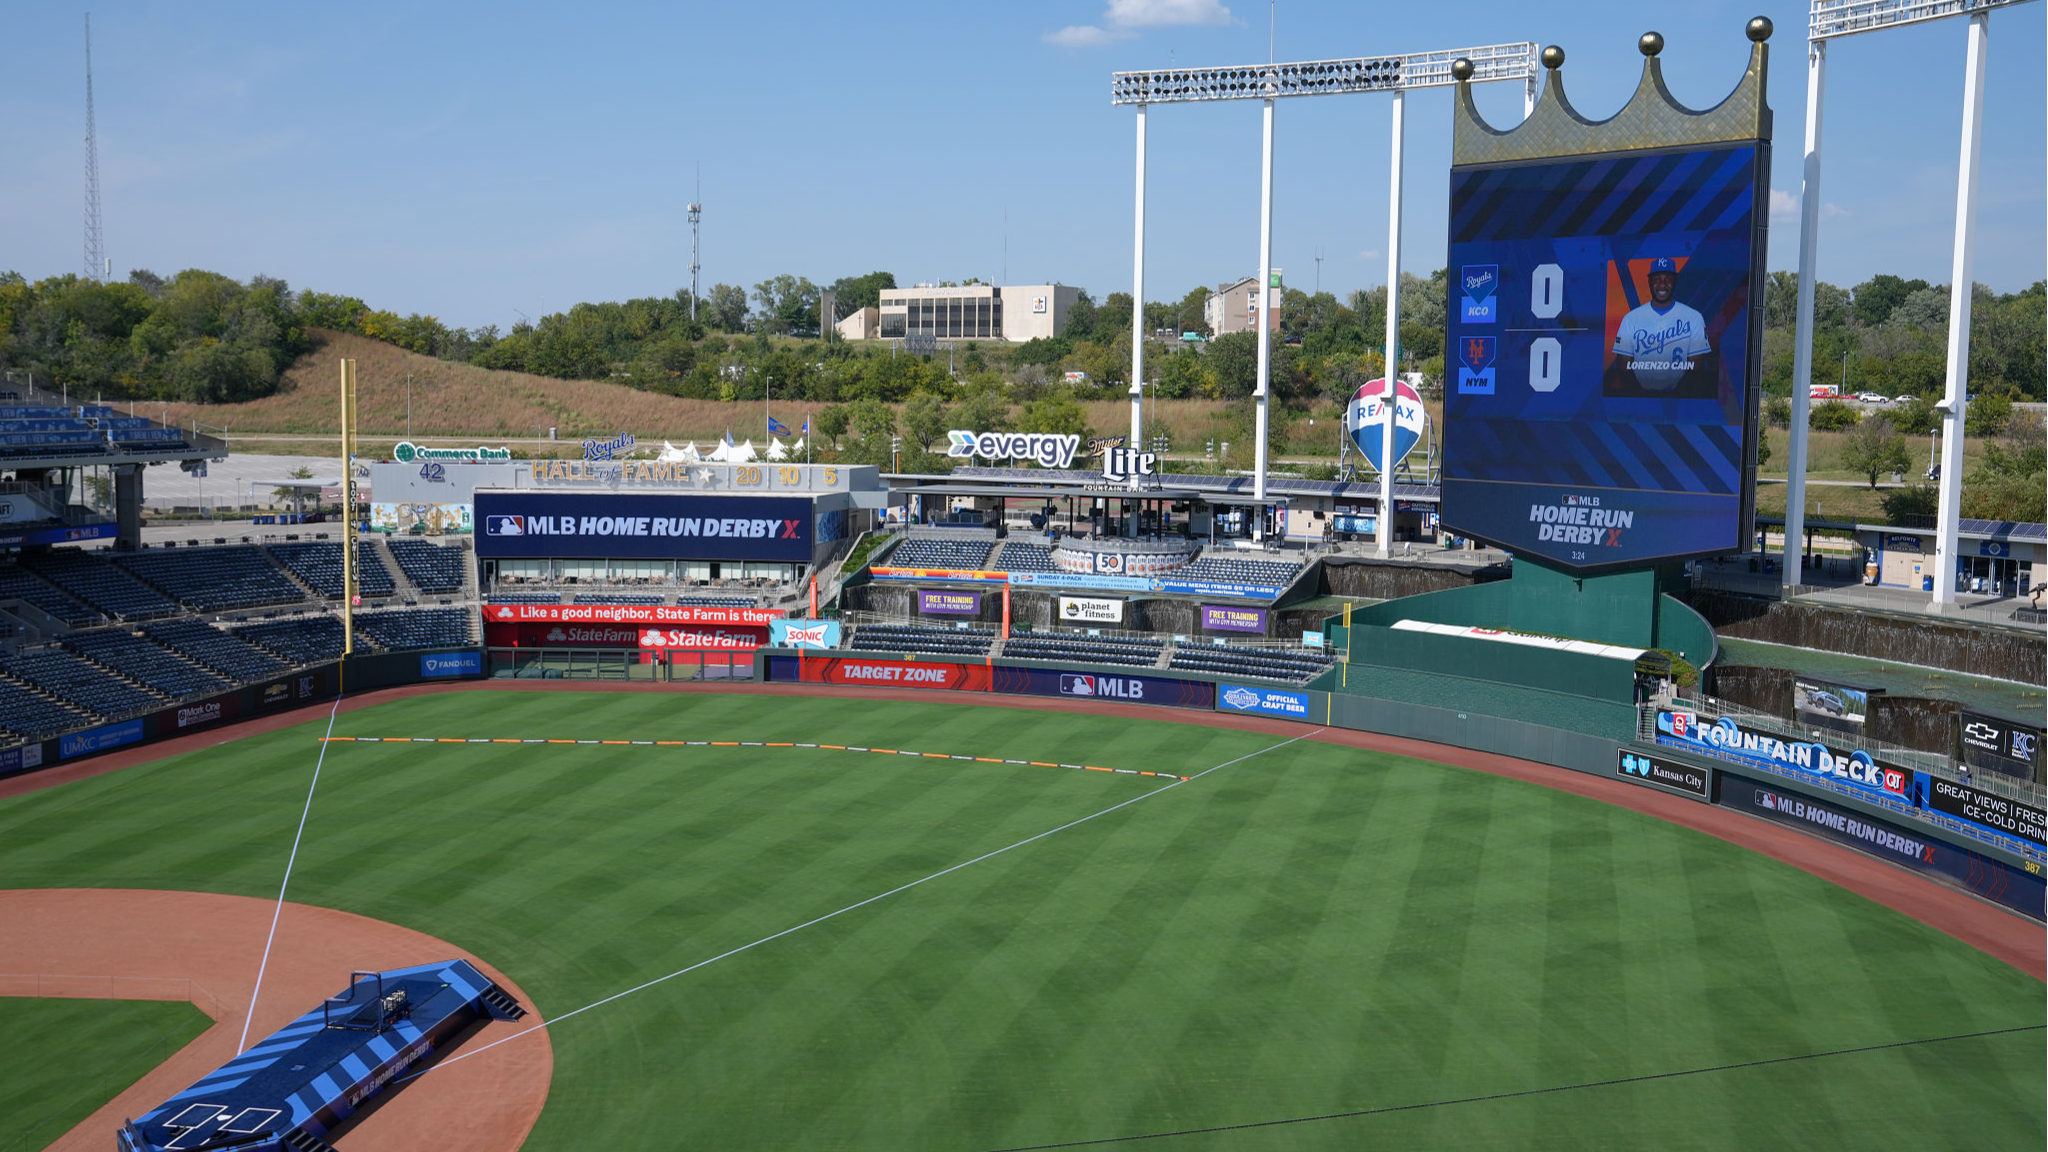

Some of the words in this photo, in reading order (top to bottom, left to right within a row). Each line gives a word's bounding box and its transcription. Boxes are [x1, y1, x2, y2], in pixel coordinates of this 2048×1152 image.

[1466, 271, 1492, 289] Royals
[1531, 263, 1563, 318] 0
[1468, 306, 1489, 316] KCO
[1633, 319, 1691, 355] Royals
[1529, 337, 1561, 392] 0
[1626, 361, 1670, 370] LORENZO
[1670, 361, 1694, 370] CAIN
[1465, 378, 1488, 387] NYM
[1357, 403, 1415, 421] RE/AX
[416, 448, 477, 460] Commerce
[480, 447, 510, 459] Bank
[582, 432, 637, 461] Royals
[980, 436, 1077, 466] evergy
[1087, 437, 1123, 453] Miller
[419, 463, 443, 480] 42
[532, 461, 594, 479] HALL
[599, 463, 622, 482] of
[621, 461, 689, 481] FAME
[1102, 447, 1157, 482] Lite
[736, 466, 760, 484] 20
[778, 466, 798, 484] 10
[824, 466, 836, 484] 5
[1083, 484, 1123, 492] FOUNTAIN
[1579, 496, 1599, 506] MLB
[1530, 505, 1589, 525] HOME
[1589, 509, 1634, 528] RUN
[80, 527, 99, 537] MLB
[528, 516, 576, 535] MLB
[579, 516, 650, 536] HOME
[651, 517, 702, 537] RUN
[702, 518, 782, 538] DERBY
[781, 519, 799, 539] X
[1538, 524, 1607, 545] DERBY
[1605, 529, 1621, 547] X
[1891, 535, 1917, 543] BELFONTE
[1571, 551, 1585, 560] 3:24
[925, 594, 941, 603] FREE
[943, 595, 973, 604] TRAINING
[1081, 602, 1110, 611] planet
[520, 606, 547, 618] Like
[551, 609, 558, 618] a
[561, 607, 592, 620] good
[595, 607, 653, 620] neighbor,
[656, 608, 690, 619] State
[693, 609, 726, 620] Farm
[729, 610, 740, 621] is
[1085, 610, 1115, 619] fitness
[1209, 609, 1226, 619] FREE
[1227, 611, 1259, 621] TRAINING
[788, 631, 822, 641] SONIC
[438, 658, 476, 669] FANDUEL
[843, 665, 902, 679] TARGET
[904, 668, 947, 682] ZONE
[1098, 678, 1143, 698] MLB
[1262, 701, 1285, 710] CRAFT
[1286, 704, 1305, 713] BEER
[1266, 694, 1298, 704] OFFICIAL
[187, 705, 204, 716] Mark
[205, 702, 221, 713] One
[64, 737, 95, 755] UMKC
[1697, 721, 1812, 767] FOUNTAIN
[1819, 751, 1880, 785] DECK
[1964, 737, 1998, 751] CHEVROLET
[2012, 730, 2035, 761] KC
[1653, 765, 1683, 782] Kansas
[1685, 774, 1702, 789] City
[1886, 772, 1903, 790] QT
[1936, 783, 1971, 801] GREAT
[1974, 793, 2007, 813] VIEWS
[2016, 807, 2047, 827] FRES
[1777, 797, 1805, 818] MLB
[1806, 806, 1847, 831] HOME
[1847, 819, 1877, 841] RUN
[1876, 829, 1925, 859] DERBY
[1963, 804, 2016, 830] ICE-COLD
[2018, 823, 2047, 841] DRIN
[2025, 861, 2040, 874] 387
[360, 1081, 375, 1100] MLB
[375, 1065, 395, 1089] HOME
[409, 1039, 431, 1063] DERBY
